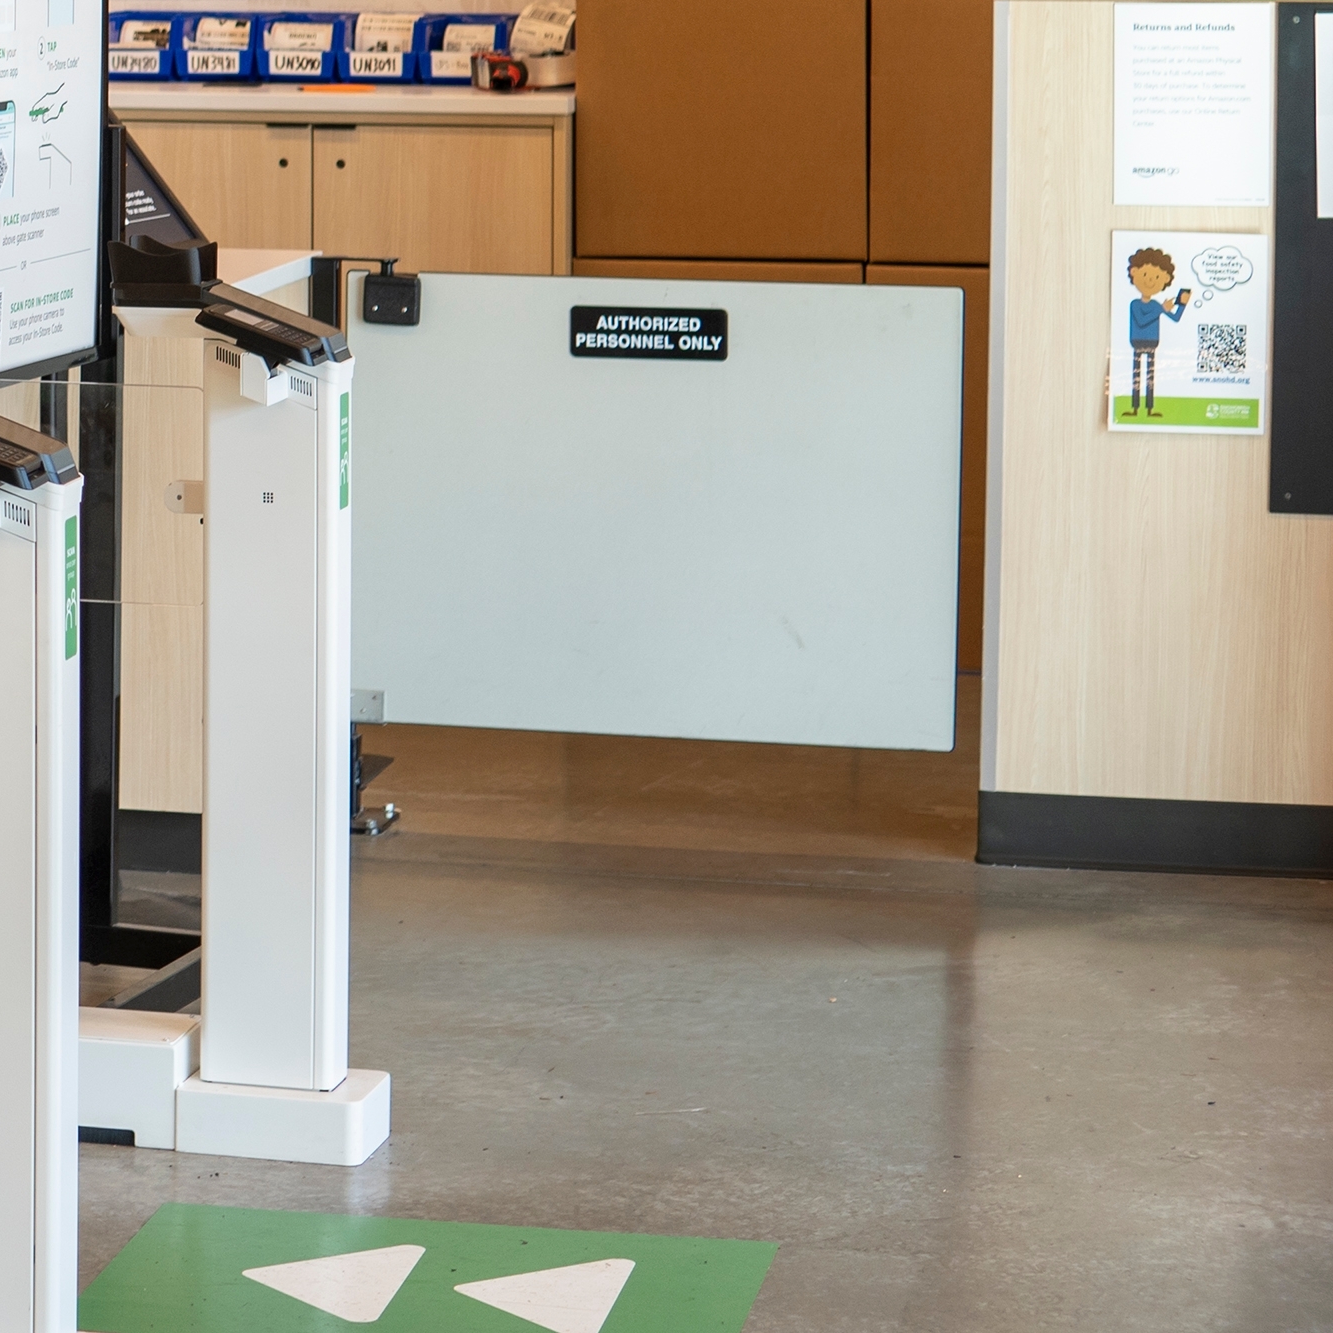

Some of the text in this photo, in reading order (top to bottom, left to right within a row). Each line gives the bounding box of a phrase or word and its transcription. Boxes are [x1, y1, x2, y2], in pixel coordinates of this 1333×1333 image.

[1133, 23, 1235, 32] Returns and Refunds
[47, 41, 57, 52] TAP
[111, 55, 157, 72] UN3480
[3, 213, 19, 226] PLACE
[596, 315, 701, 332] AUTHORIZED
[575, 333, 723, 352] PERSONNEL ONLY
